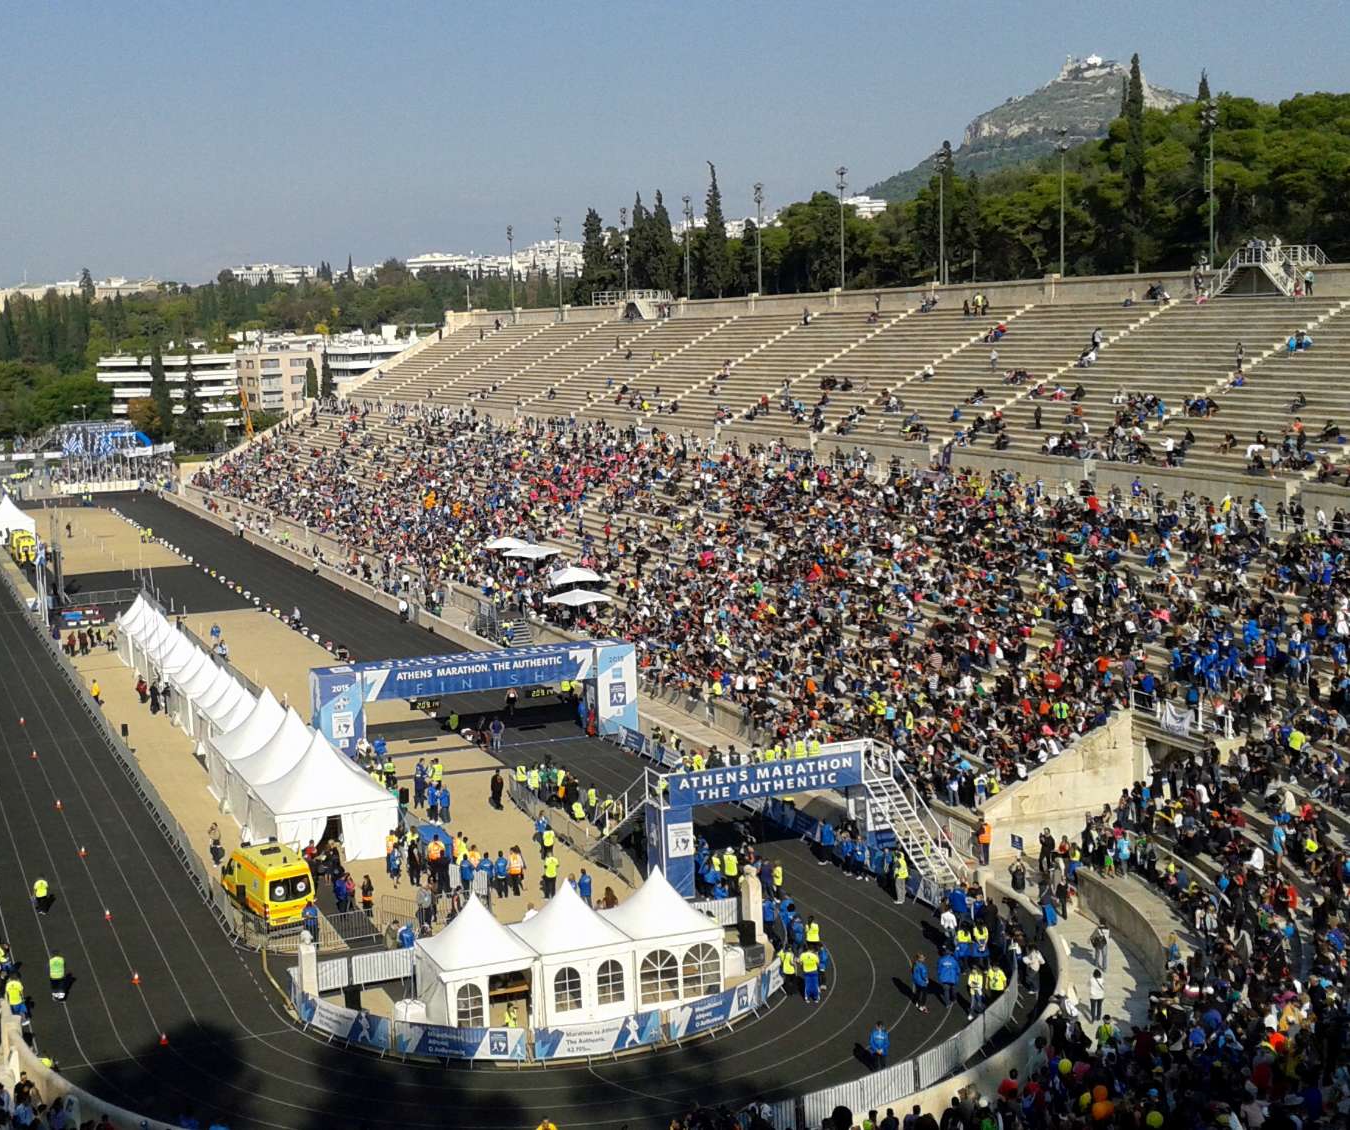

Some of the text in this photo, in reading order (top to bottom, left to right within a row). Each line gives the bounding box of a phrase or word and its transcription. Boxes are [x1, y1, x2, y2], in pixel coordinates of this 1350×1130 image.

[396, 670, 433, 681] ATHENS
[492, 661, 511, 672] THE
[512, 655, 563, 670] AUTHENTIC
[331, 683, 350, 693] 2015
[416, 672, 545, 694] FINISH
[679, 756, 853, 790] ATHENS MARATHON
[697, 772, 837, 801] THE AUTHENTIC
